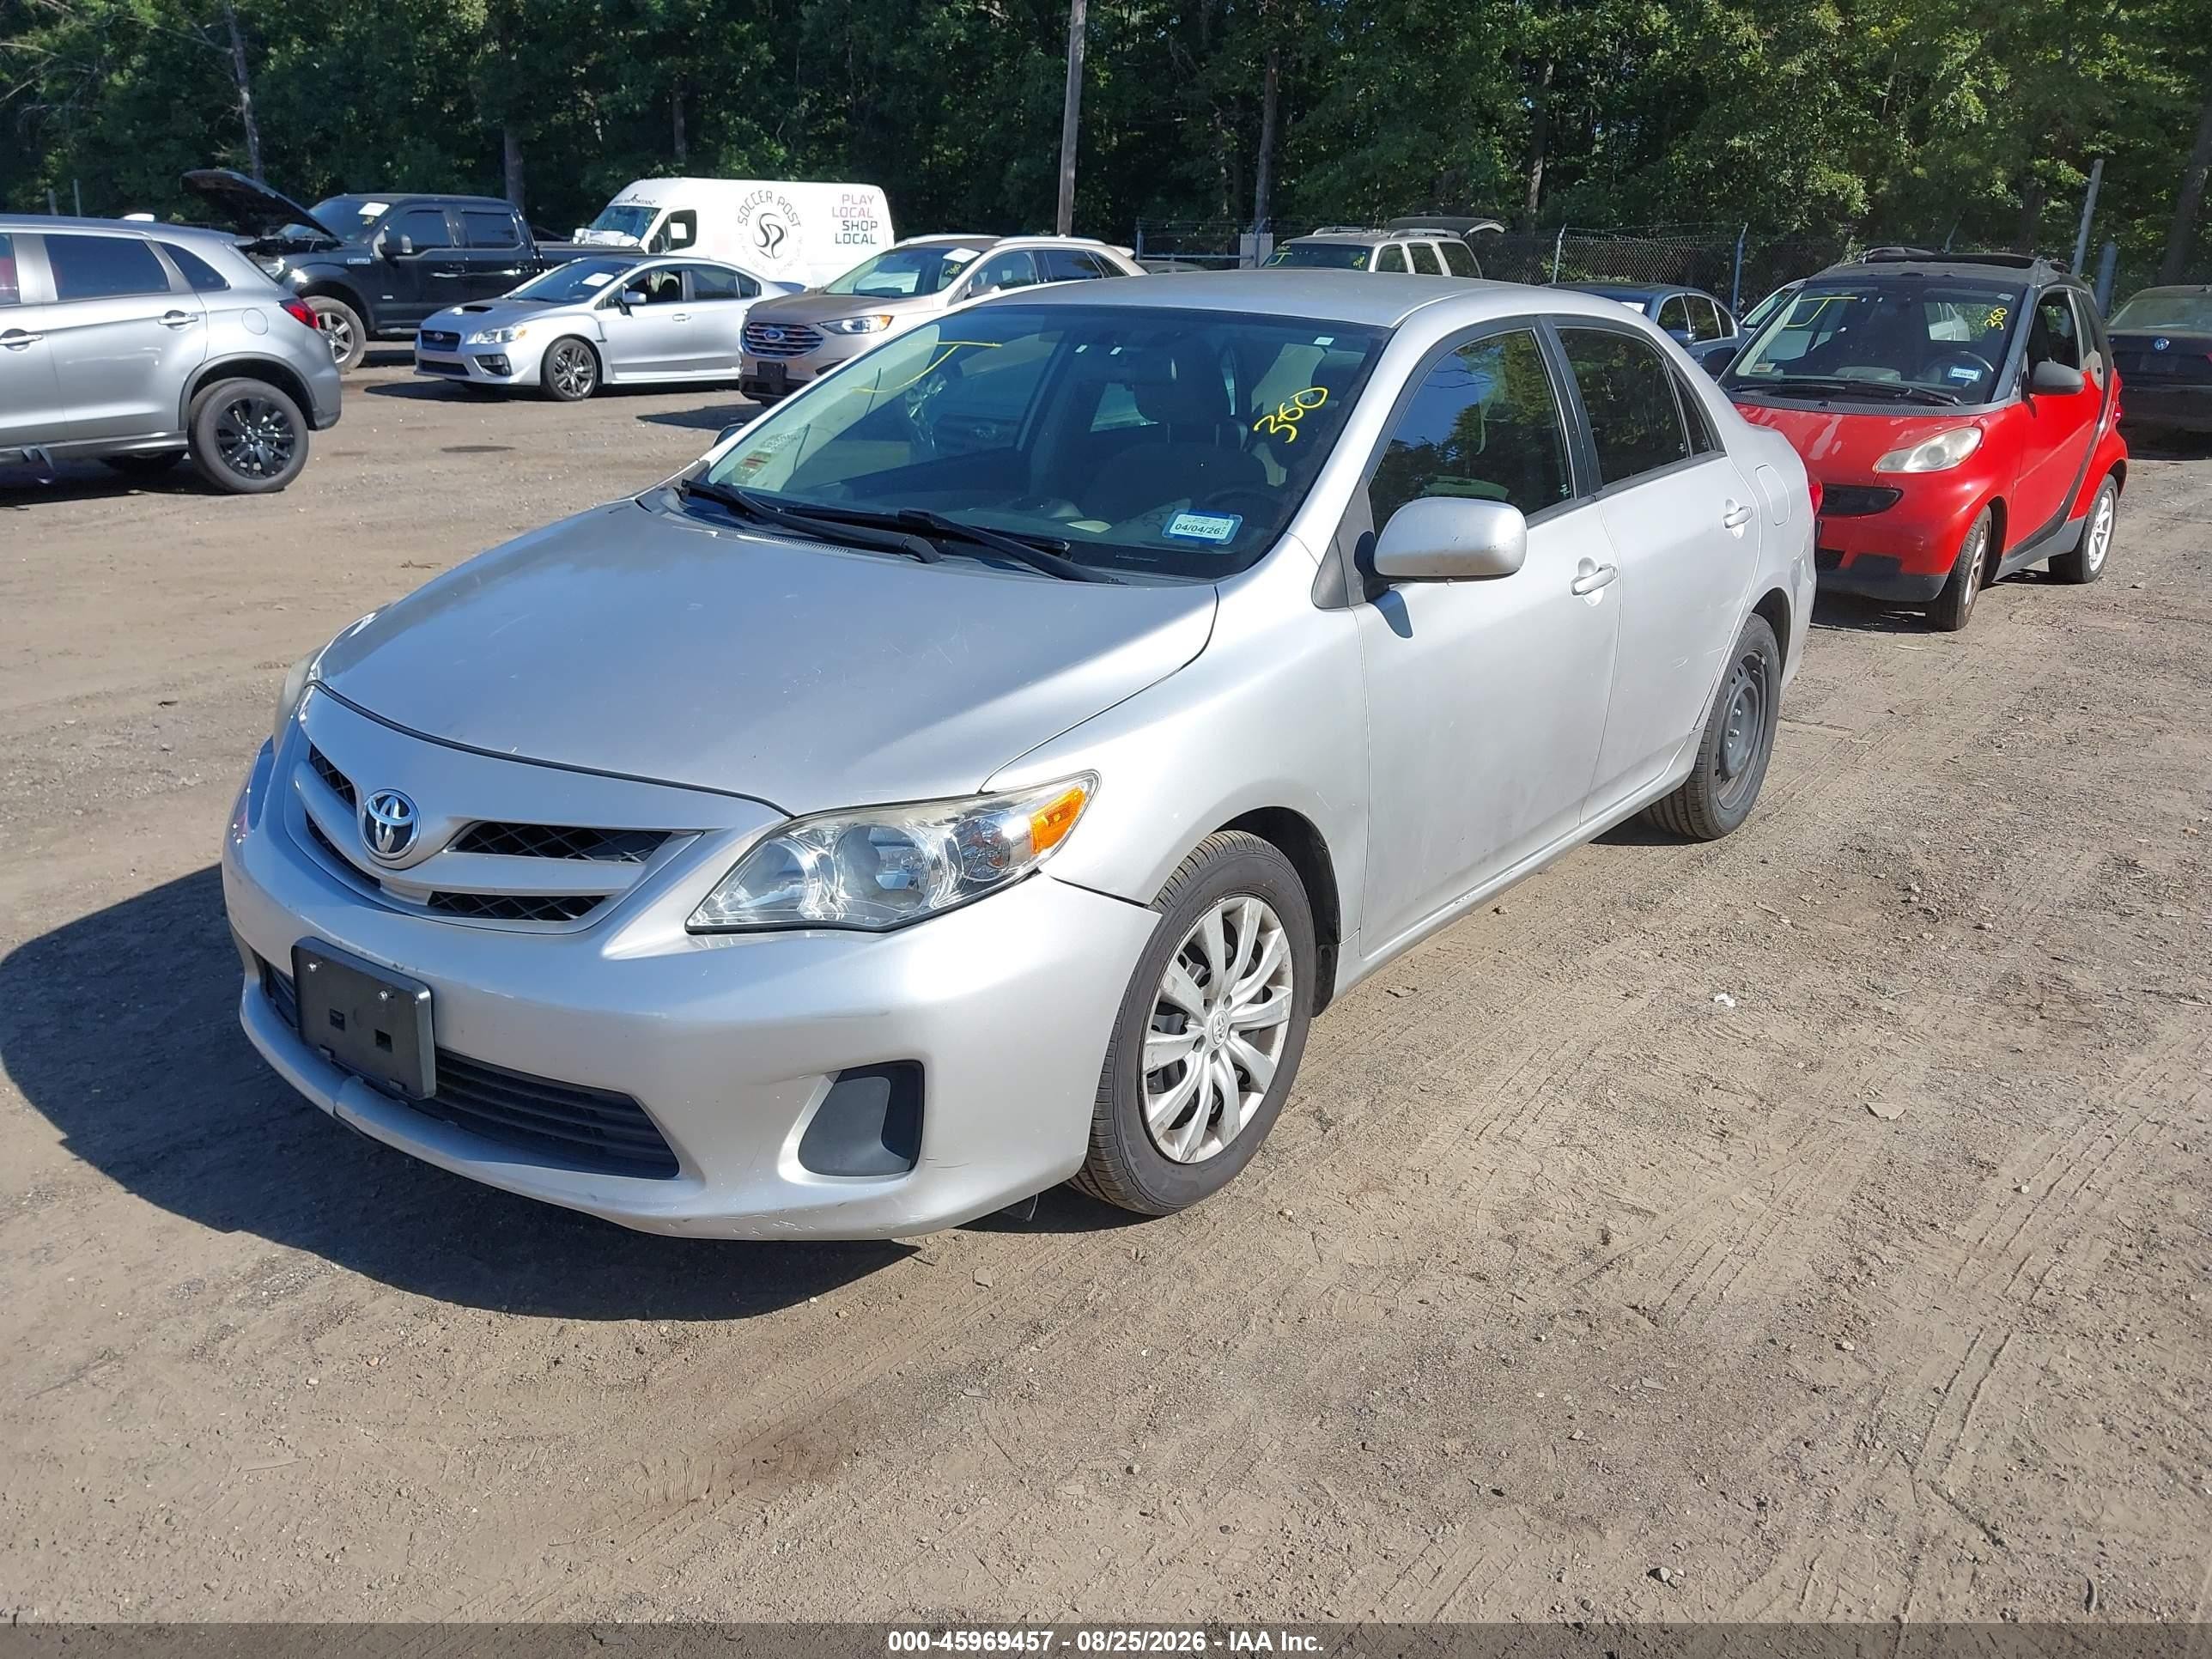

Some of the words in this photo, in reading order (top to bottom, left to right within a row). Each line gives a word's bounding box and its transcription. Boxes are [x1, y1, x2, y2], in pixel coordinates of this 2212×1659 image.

[842, 194, 874, 204] PLAY
[738, 190, 773, 227] SOCCER
[776, 196, 801, 228] POST
[832, 207, 873, 218] LOCAL
[842, 221, 878, 231] SHOP
[836, 234, 877, 245] LOCAL
[1984, 307, 2008, 331] 360
[1254, 387, 1328, 443] 360
[1175, 522, 1220, 535] 04/04/26
